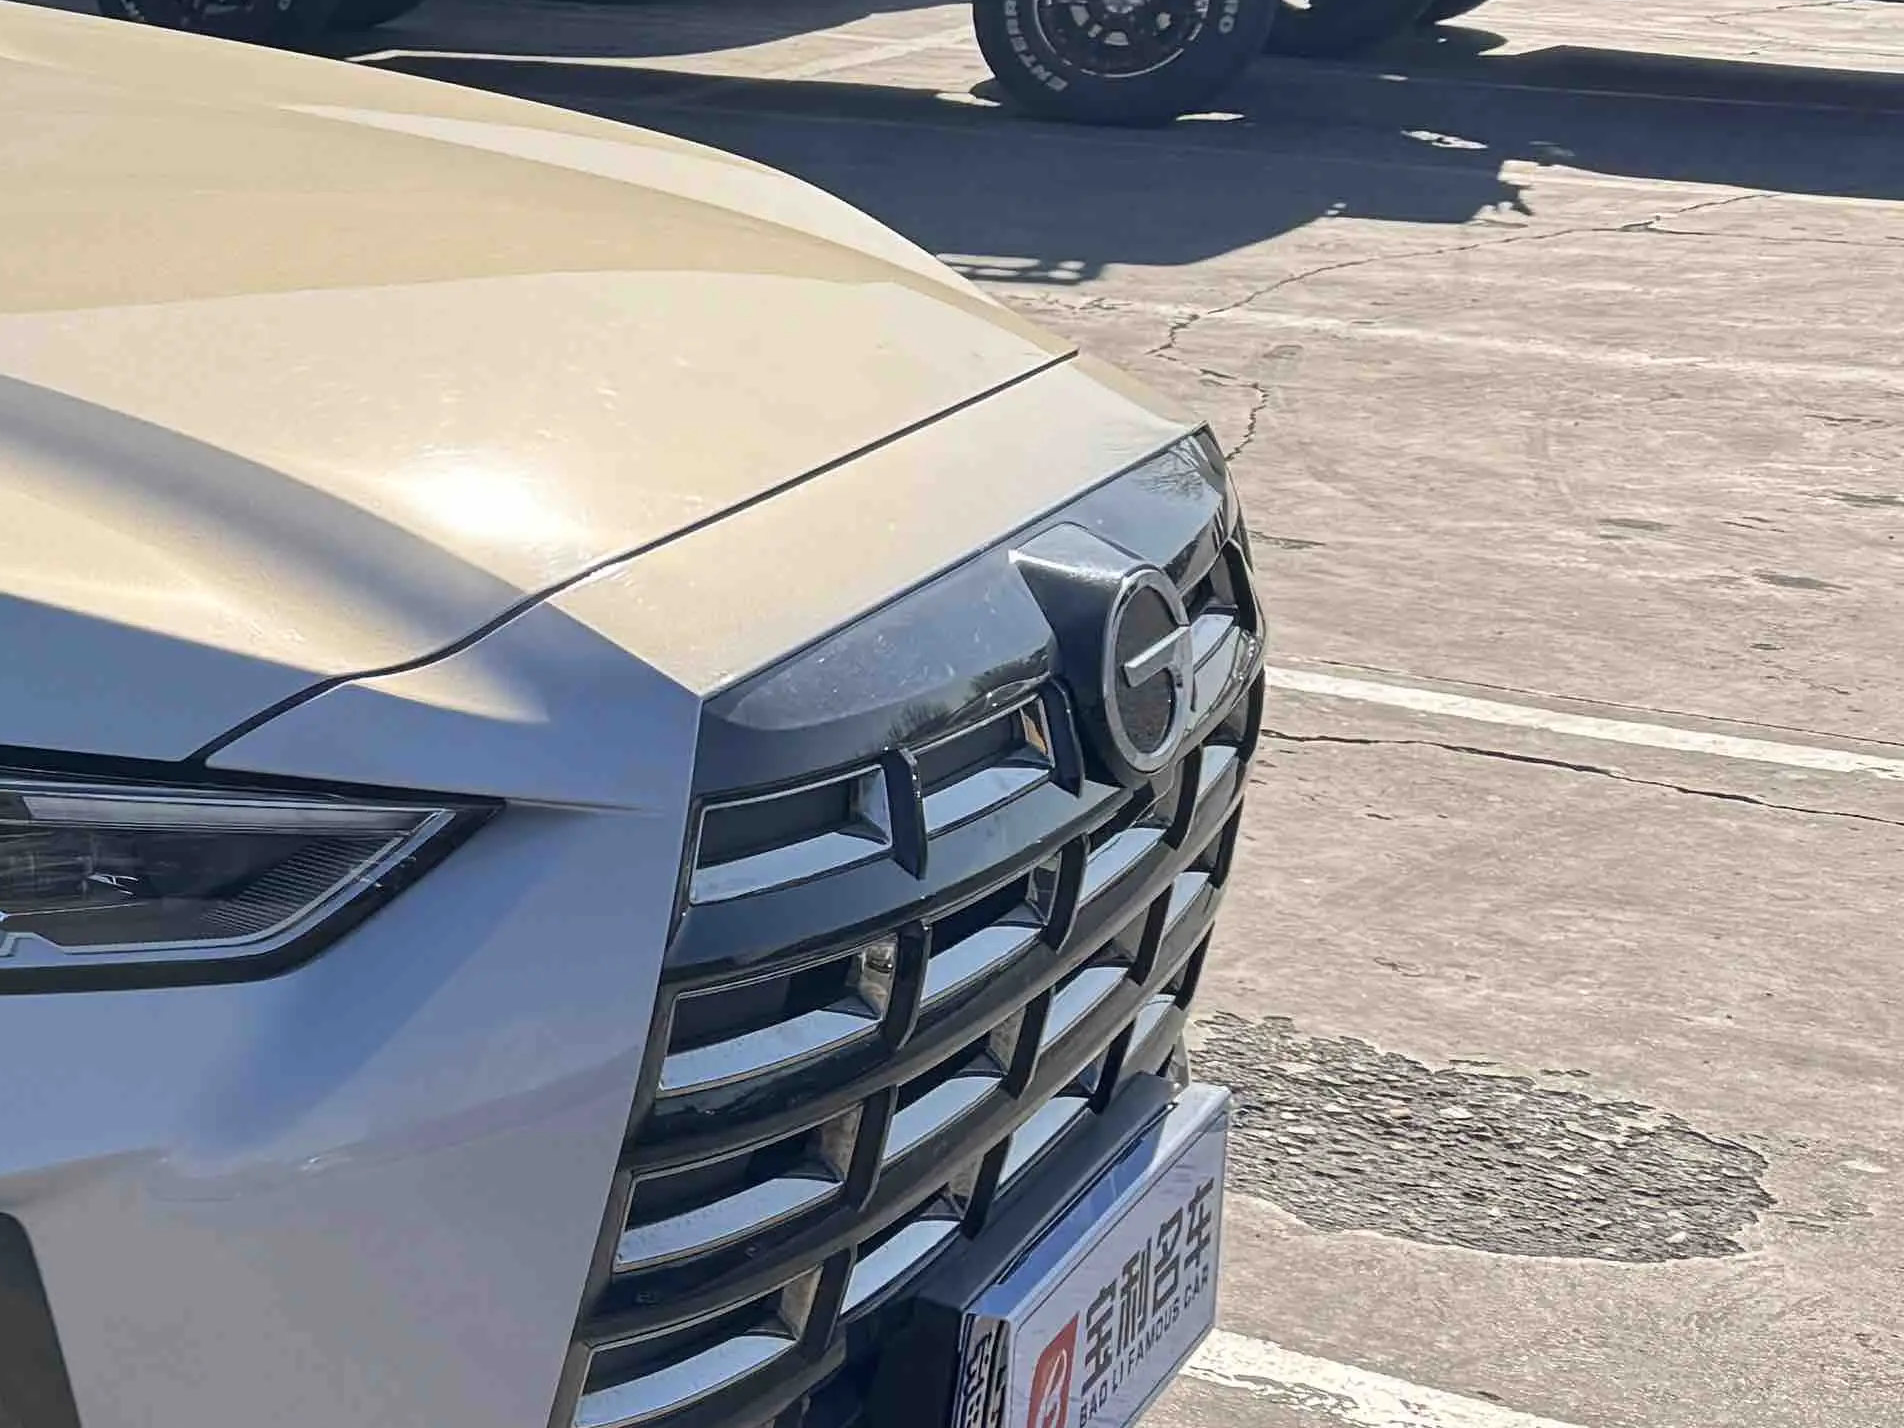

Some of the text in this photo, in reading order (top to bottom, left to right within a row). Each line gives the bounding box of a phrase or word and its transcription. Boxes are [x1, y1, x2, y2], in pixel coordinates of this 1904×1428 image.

[1081, 1176, 1215, 1397] 宝利名车
[1127, 1296, 1181, 1376] FAMOUS
[1183, 1260, 1210, 1310] CAR
